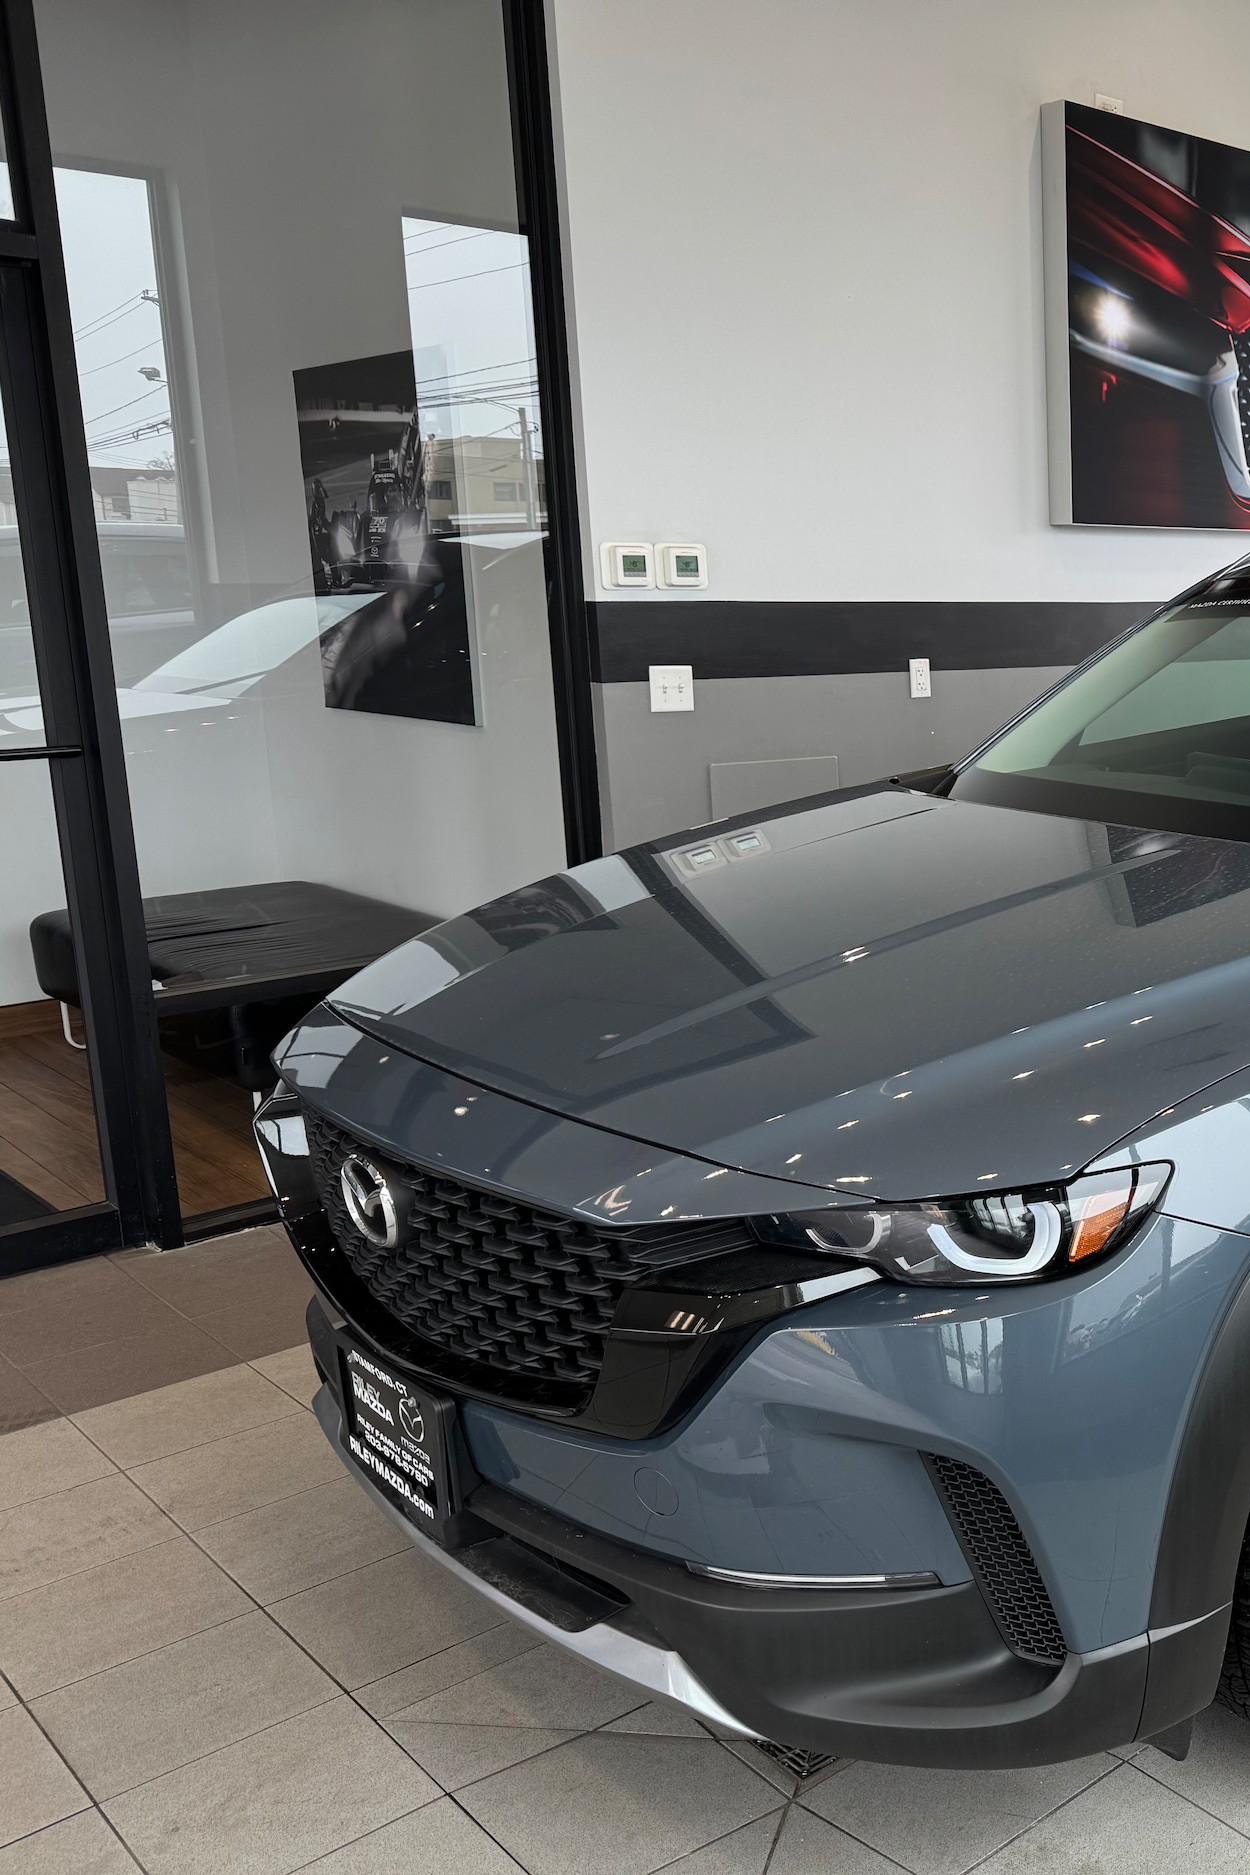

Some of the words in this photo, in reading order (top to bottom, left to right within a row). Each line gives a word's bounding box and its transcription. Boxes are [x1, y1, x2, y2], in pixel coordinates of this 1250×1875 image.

[351, 1370, 380, 1401] RILEY
[353, 1384, 395, 1427] MAZDA
[357, 1413, 375, 1434] RILEY
[375, 1428, 401, 1454] FAMILY
[401, 1449, 412, 1463] OF
[412, 1458, 434, 1481] CARS
[349, 1435, 434, 1520] RILEYMAZDA.com
